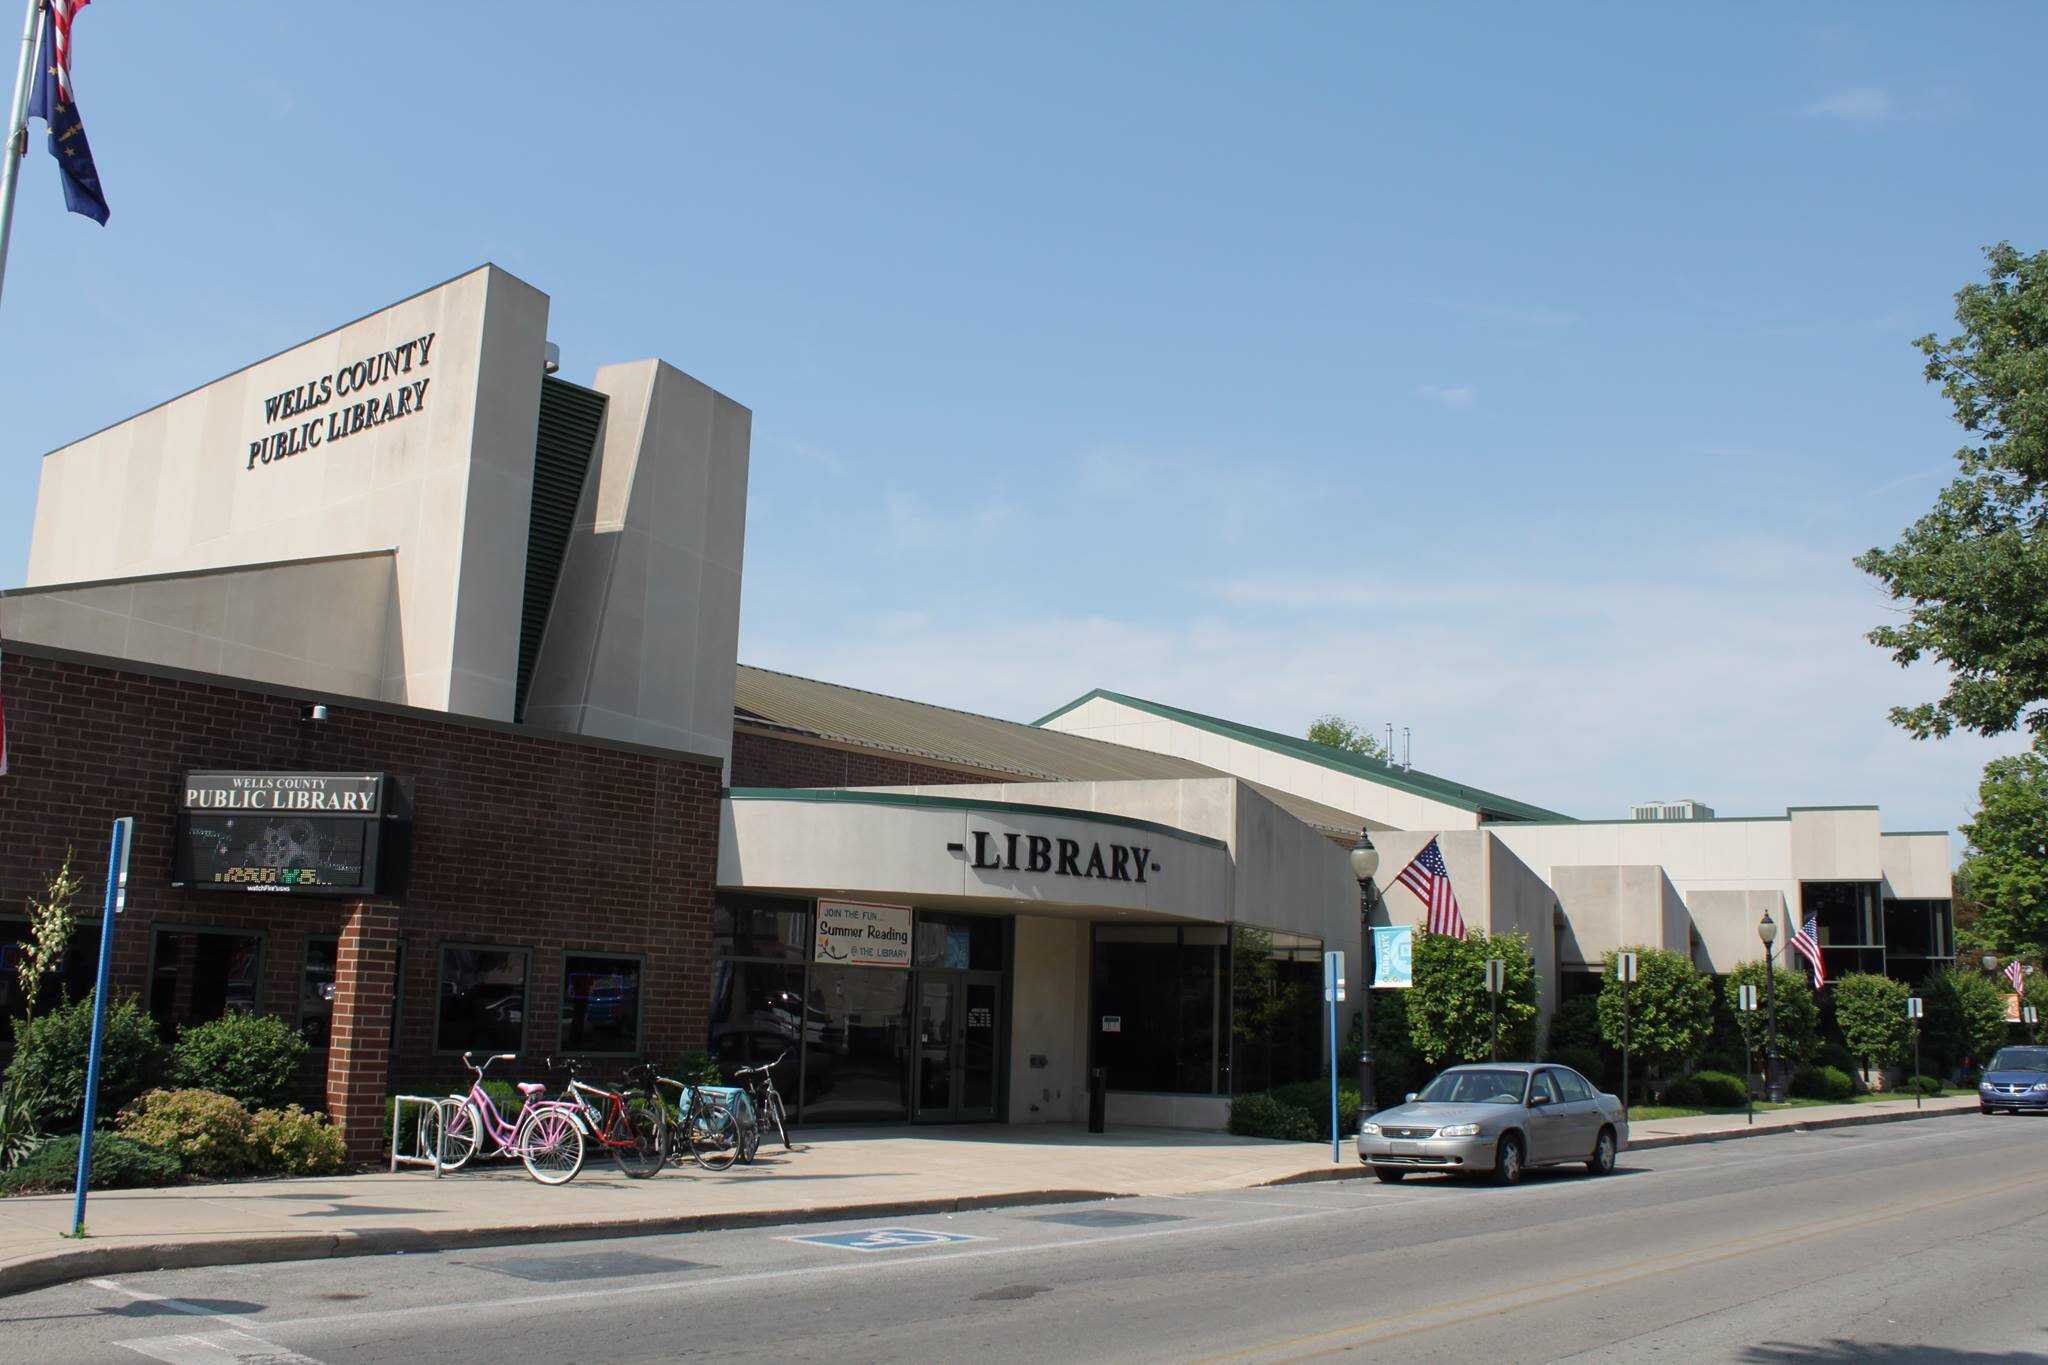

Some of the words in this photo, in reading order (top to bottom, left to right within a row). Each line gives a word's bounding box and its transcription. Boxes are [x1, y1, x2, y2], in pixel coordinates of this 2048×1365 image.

[264, 374, 333, 424] WELLS
[336, 332, 435, 397] COUNTY
[246, 416, 324, 471] PUBLIC
[326, 378, 430, 442] LIBRARY
[233, 778, 274, 789] WELLS
[276, 779, 327, 790] COUNTY
[186, 789, 265, 809] PUBLIC
[272, 790, 374, 811] LIBRARY
[971, 831, 1151, 882] LIBRARY
[824, 908, 842, 919] JOIN
[844, 909, 859, 920] THE
[819, 921, 863, 938] Summer
[867, 924, 908, 944] Reading
[859, 946, 874, 957] THE
[876, 948, 908, 959] LIBRARY
